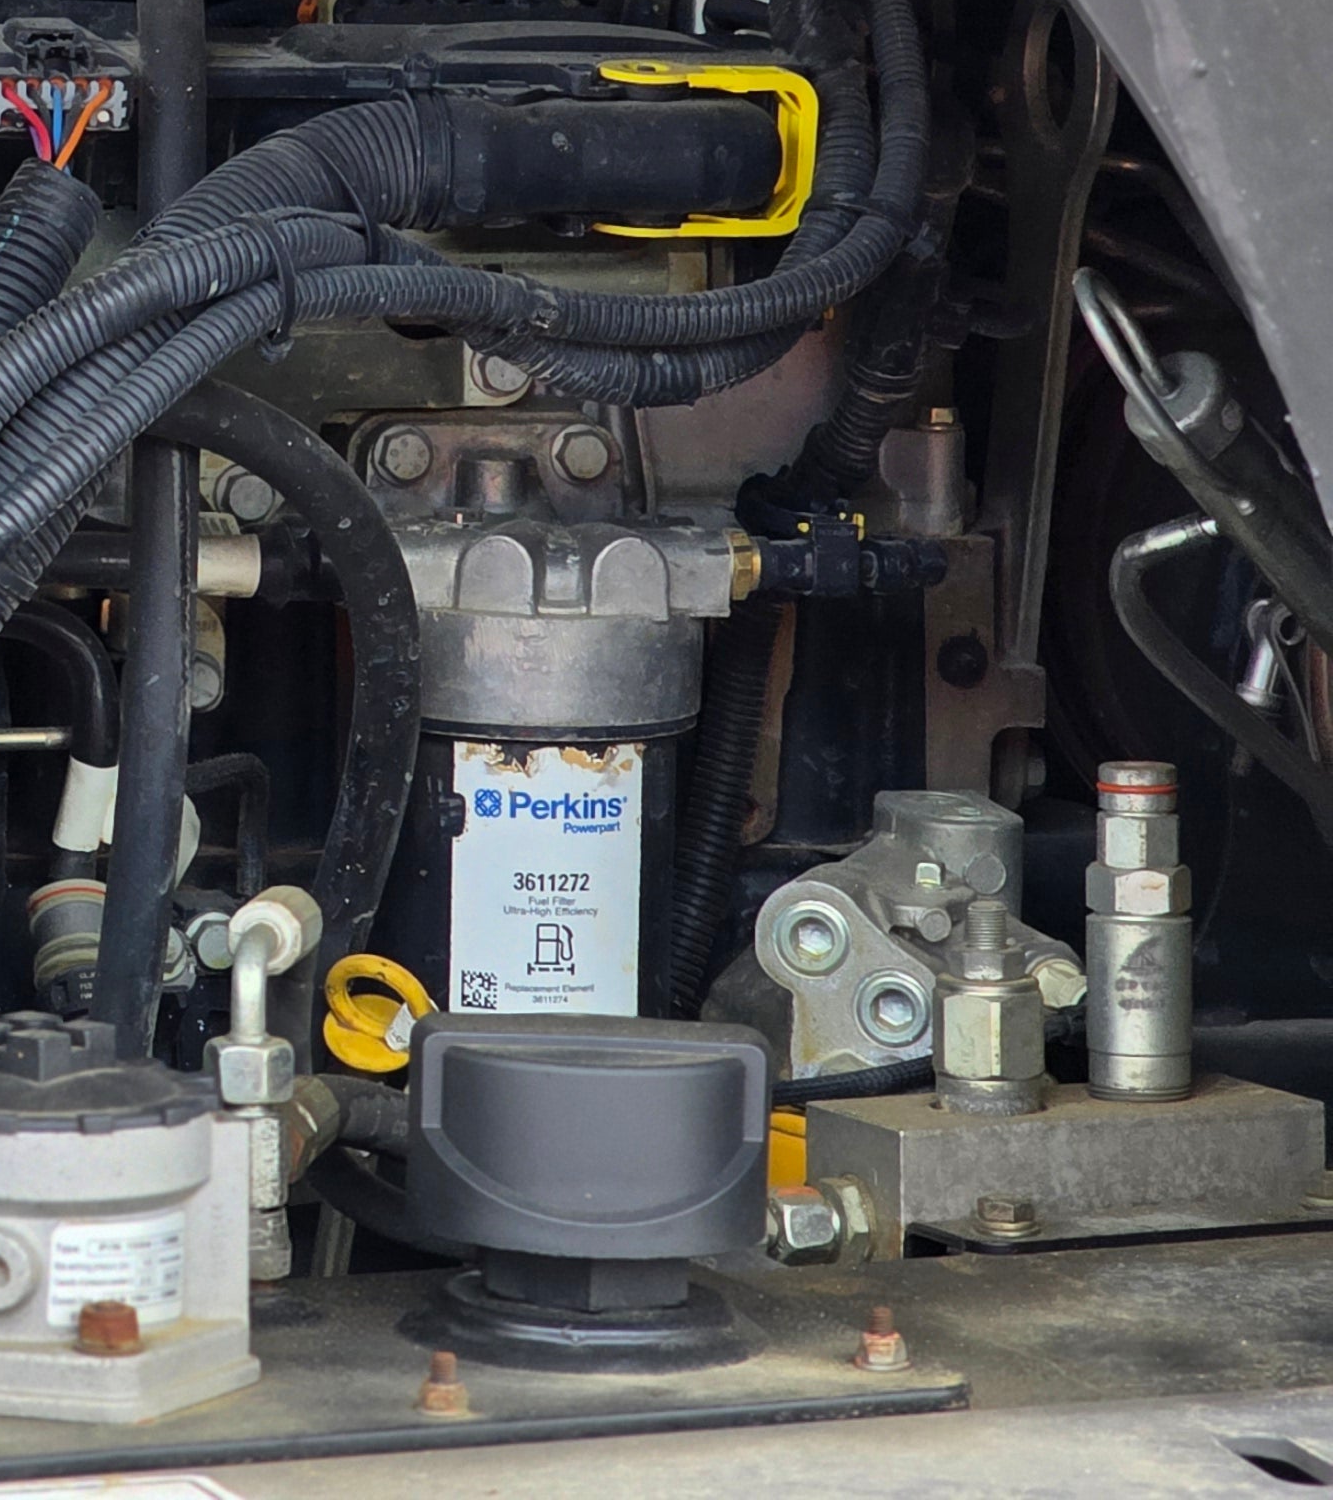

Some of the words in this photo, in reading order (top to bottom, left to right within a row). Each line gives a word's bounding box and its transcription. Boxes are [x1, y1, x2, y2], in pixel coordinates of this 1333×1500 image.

[509, 791, 622, 820] Perkins
[563, 821, 621, 835] Powerpart
[513, 872, 591, 892] 3611272
[528, 895, 550, 906] Fuel
[552, 895, 576, 906] Filter
[503, 904, 552, 918] Ultra-High
[555, 906, 599, 918] Efficiency
[504, 982, 560, 994] Replacement
[562, 983, 595, 993] Element
[532, 995, 569, 1004] 3611274
